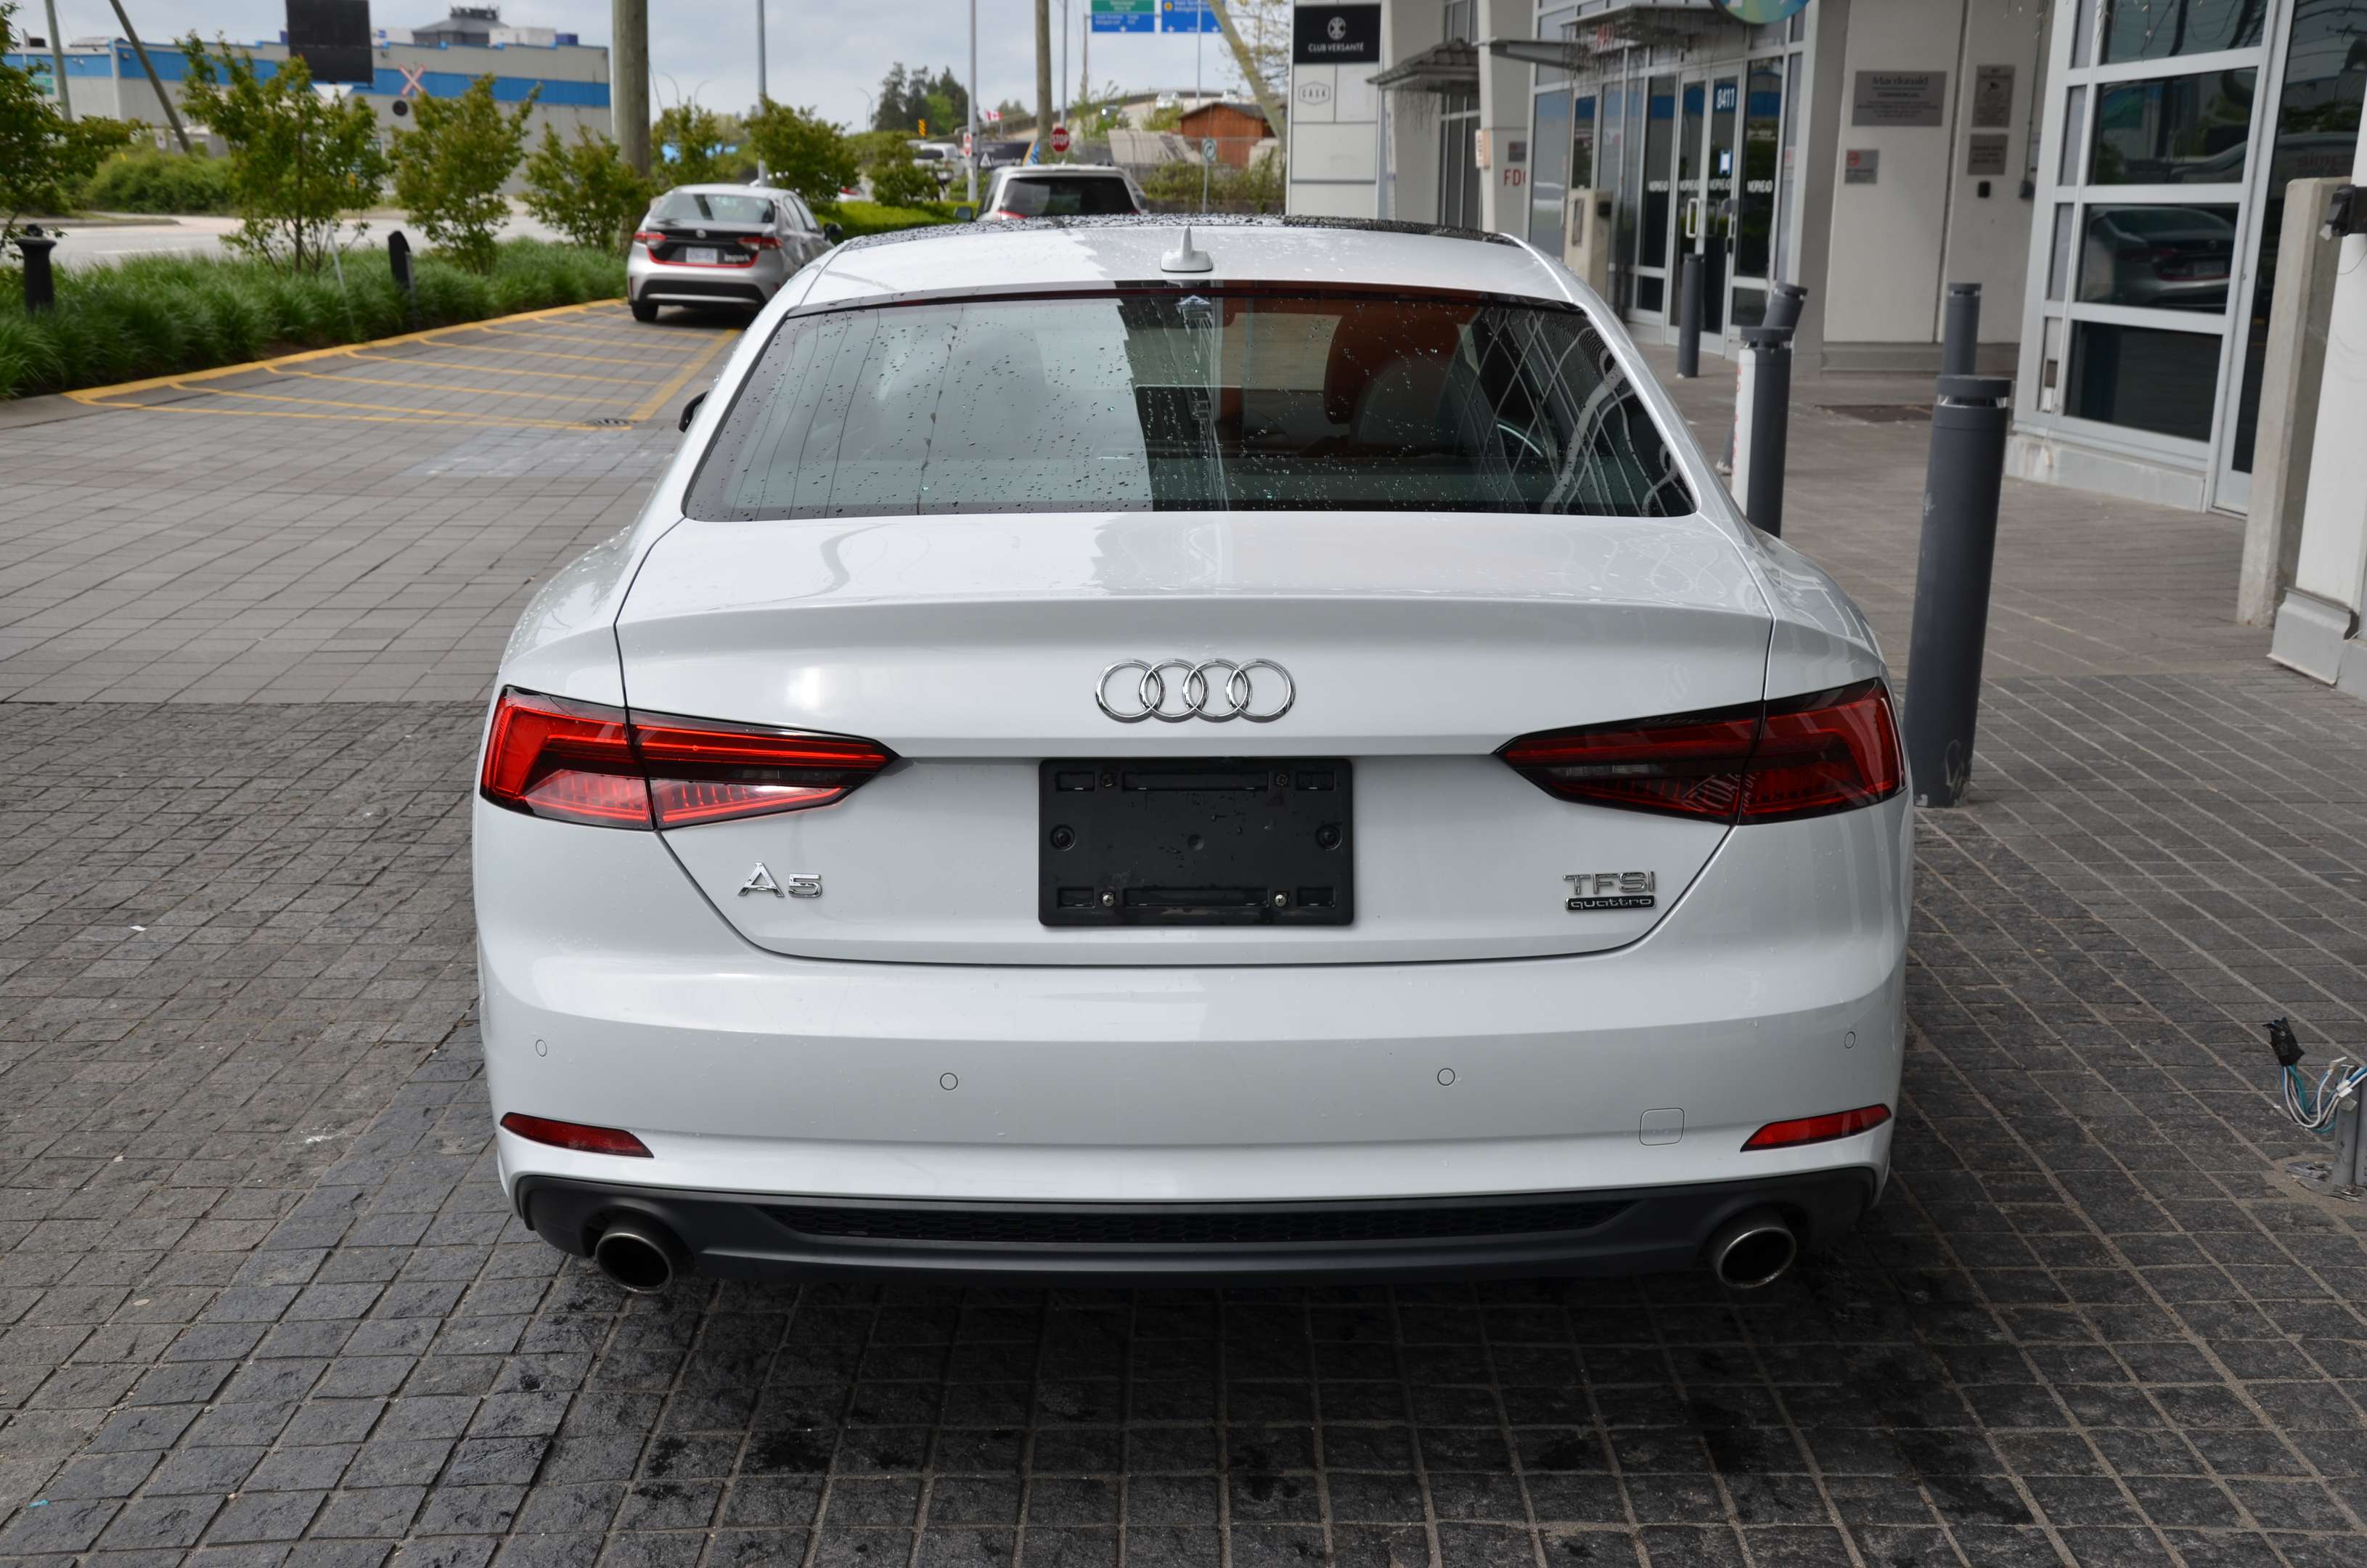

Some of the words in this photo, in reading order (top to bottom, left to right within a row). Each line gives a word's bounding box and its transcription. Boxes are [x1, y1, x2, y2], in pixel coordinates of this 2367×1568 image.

[1308, 43, 1327, 52] CLUB
[1873, 75, 1929, 85] Macdonald
[1717, 87, 1735, 109] 8411
[1051, 134, 1070, 144] STOP
[737, 862, 822, 899] A5
[1563, 871, 1655, 895] TFSI
[1570, 898, 1652, 910] quattro
